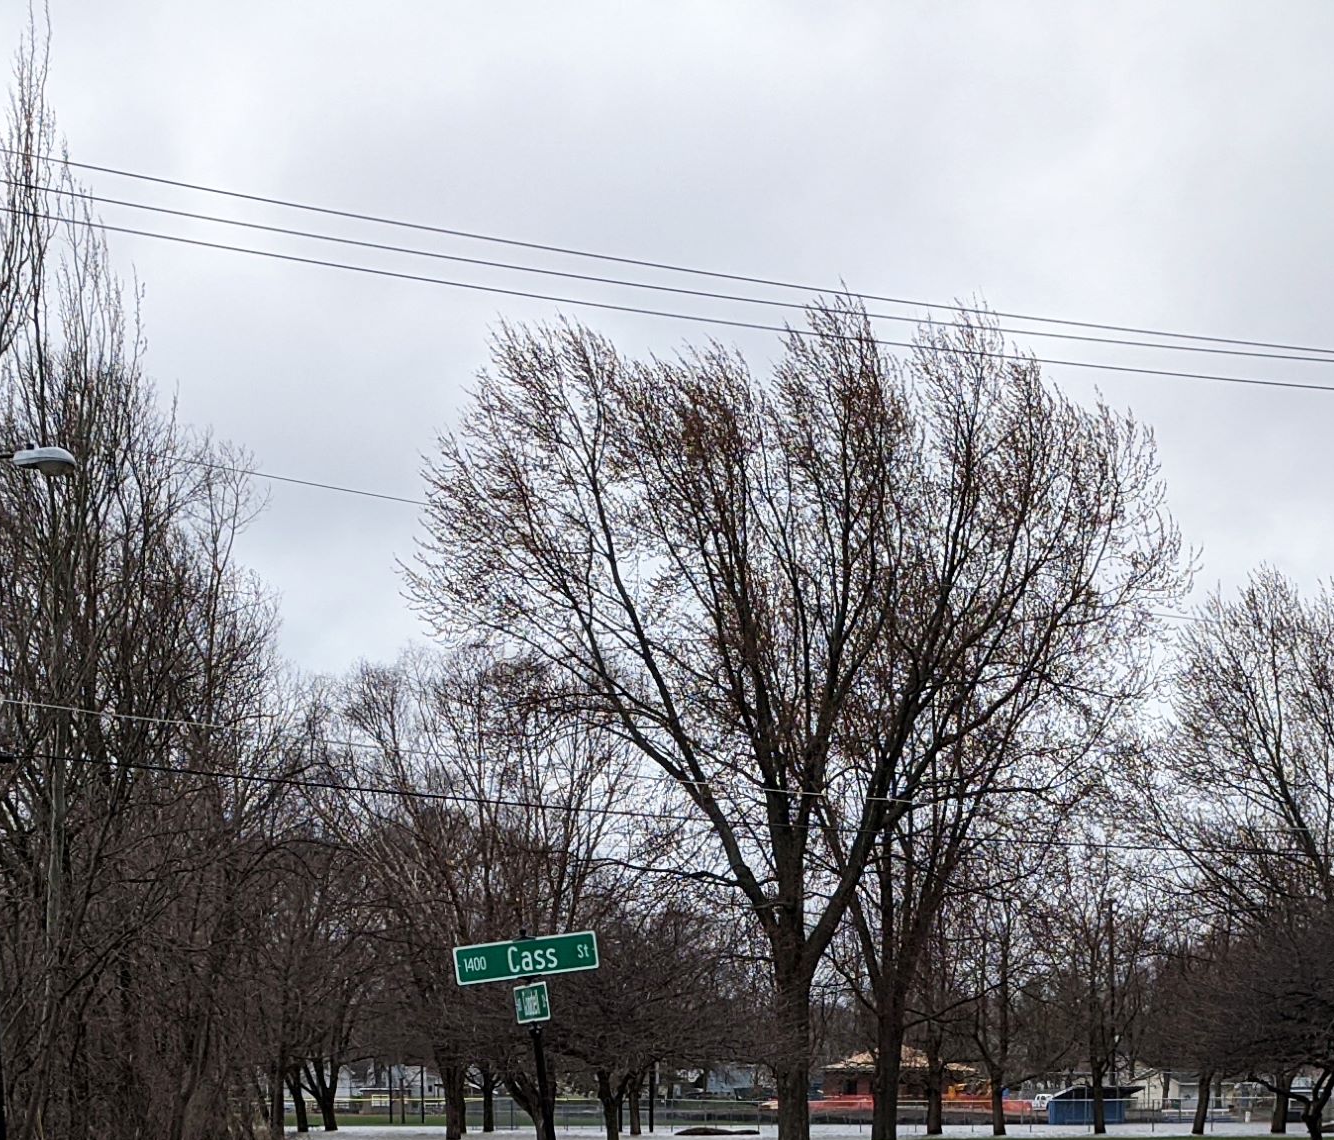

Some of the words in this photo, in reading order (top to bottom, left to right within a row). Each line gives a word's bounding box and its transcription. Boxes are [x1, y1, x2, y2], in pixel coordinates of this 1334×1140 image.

[463, 956, 487, 973] 1400
[507, 945, 558, 973] Cass
[576, 944, 589, 959] St
